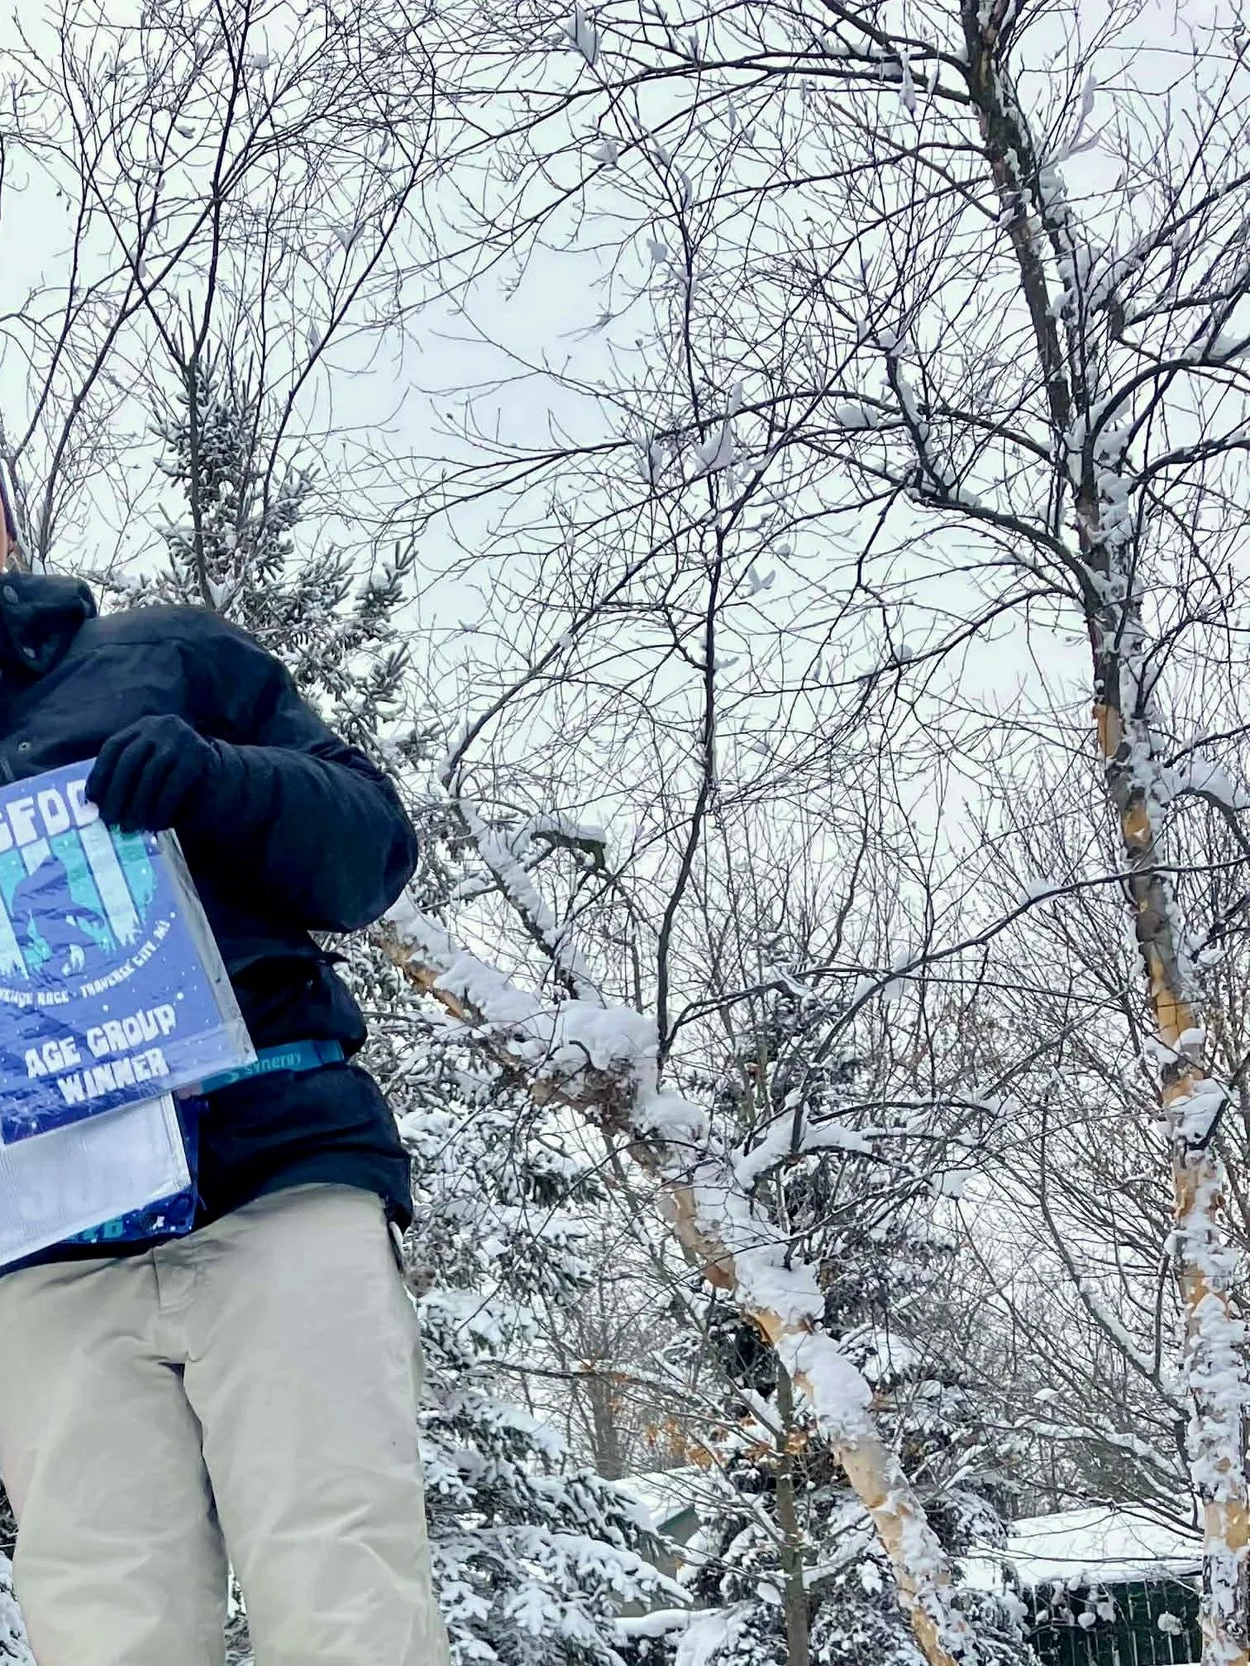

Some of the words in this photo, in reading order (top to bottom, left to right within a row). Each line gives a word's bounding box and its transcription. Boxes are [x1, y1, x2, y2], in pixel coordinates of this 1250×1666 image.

[23, 1039, 82, 1079] AGE
[85, 1003, 177, 1055] GROUP
[57, 1046, 171, 1105] WINNER
